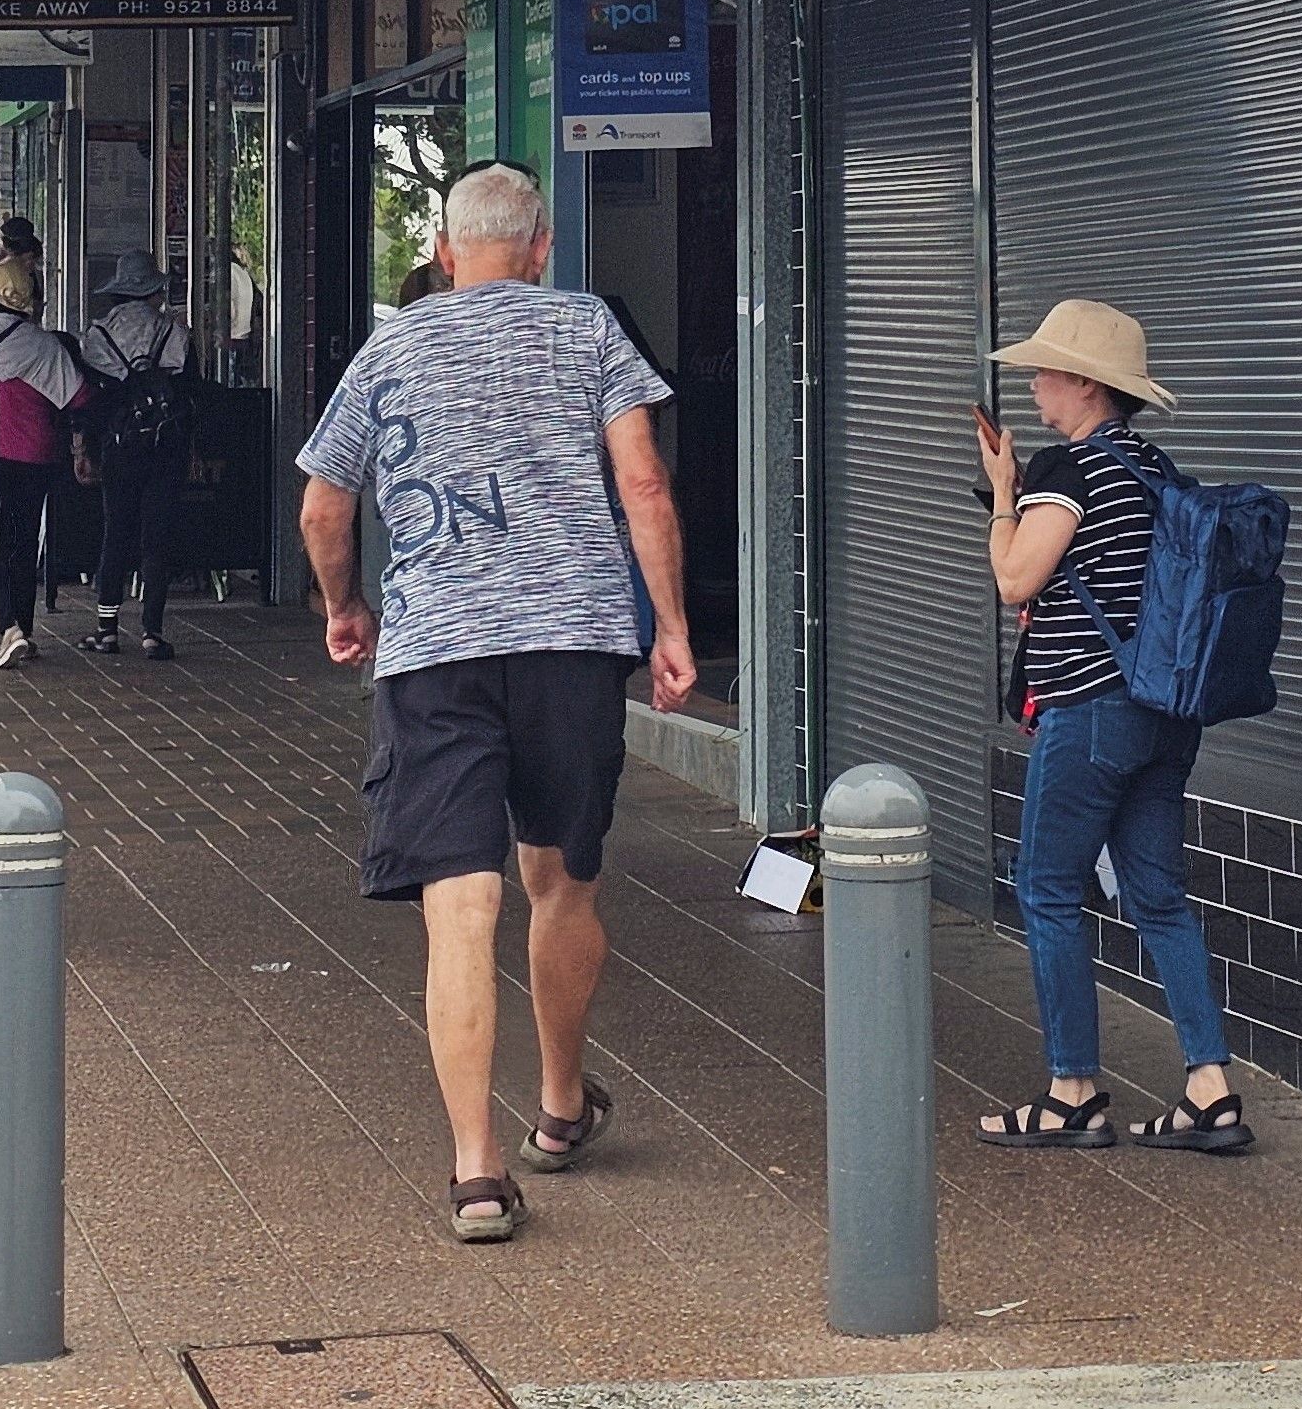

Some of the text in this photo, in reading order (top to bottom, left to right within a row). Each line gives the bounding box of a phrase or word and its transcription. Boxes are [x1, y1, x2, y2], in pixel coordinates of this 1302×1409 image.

[36, 1, 91, 16] AWAY
[117, 1, 150, 14] PH:
[164, 0, 212, 14] 9521
[225, 0, 278, 13] 8844
[579, 70, 619, 85] cards
[639, 70, 662, 85] top
[665, 71, 691, 85] ups
[619, 130, 661, 140] Transport
